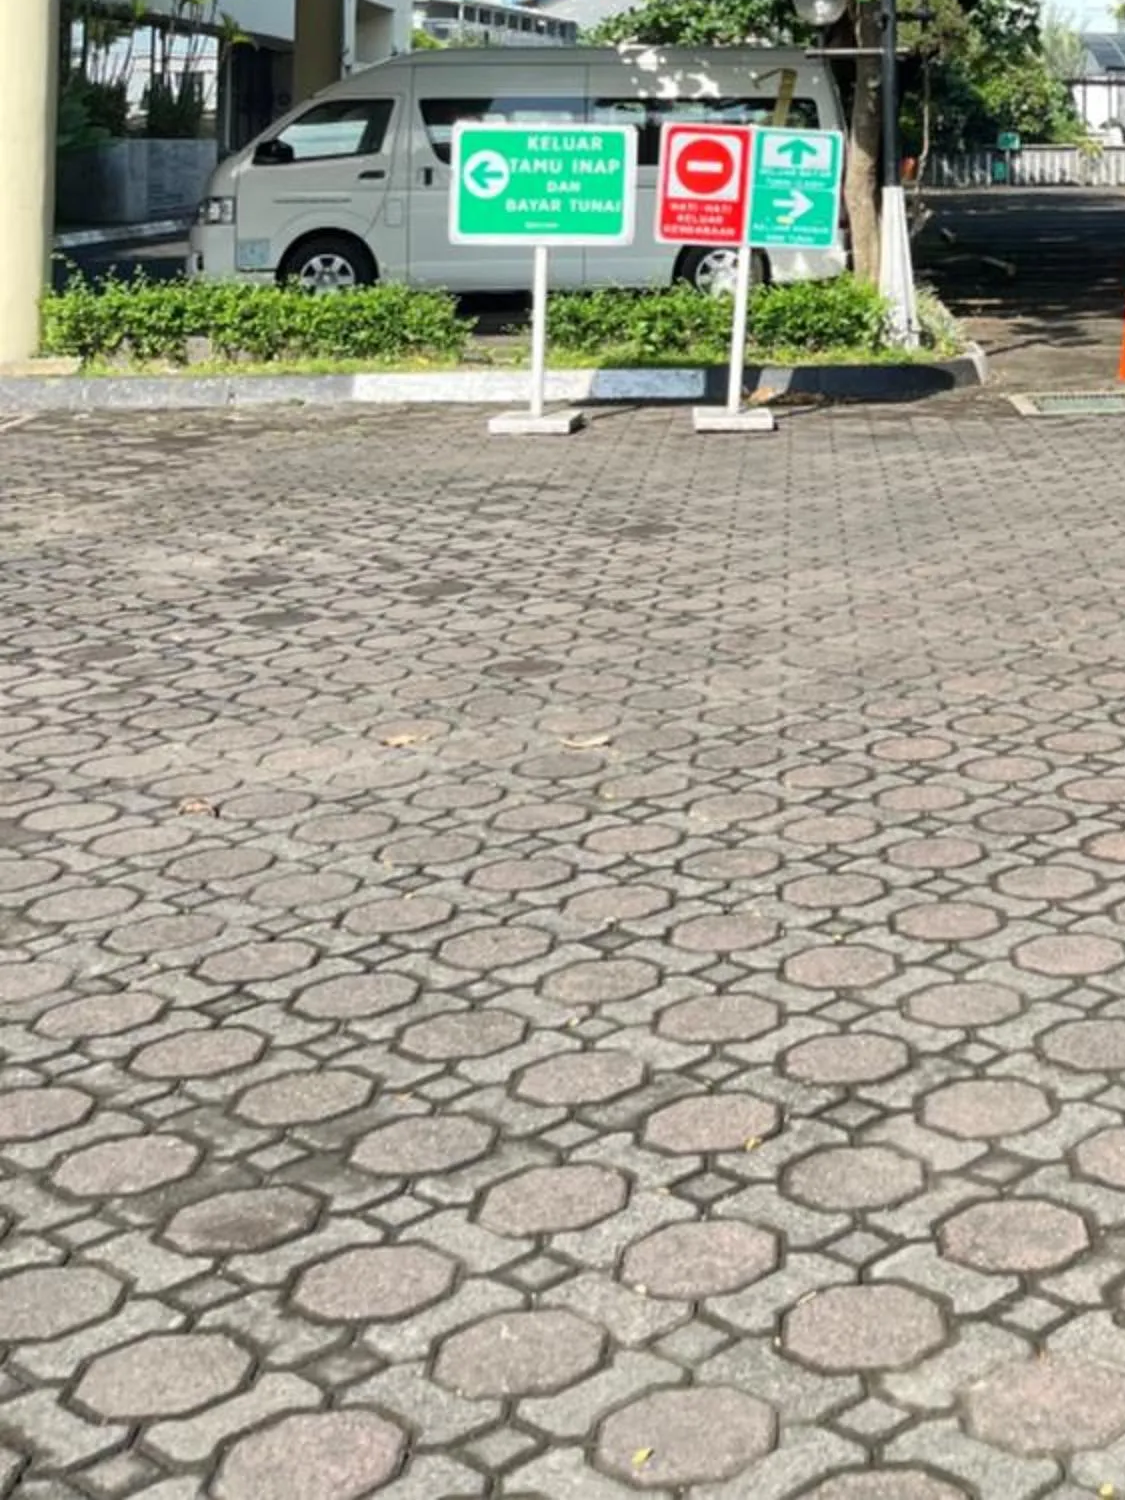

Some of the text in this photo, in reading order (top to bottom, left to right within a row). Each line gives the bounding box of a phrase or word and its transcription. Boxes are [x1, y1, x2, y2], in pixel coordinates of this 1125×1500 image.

[527, 135, 603, 151] KELUAR
[510, 158, 621, 175] TAMU INAP
[546, 180, 582, 193] DAN
[505, 198, 622, 212] BAYAR TUNAI
